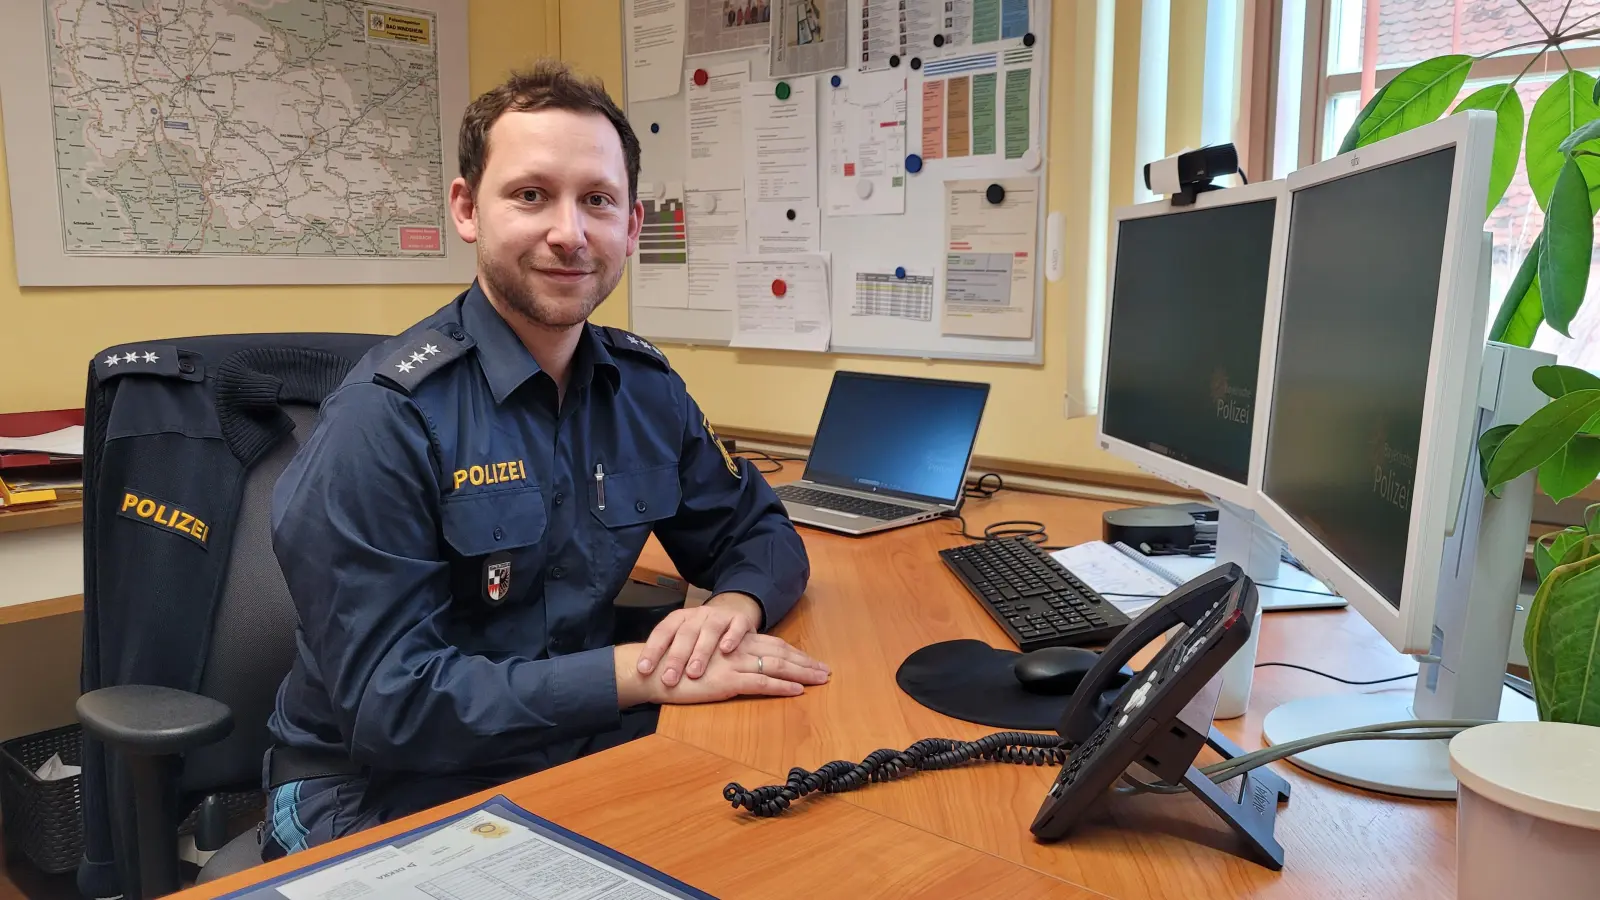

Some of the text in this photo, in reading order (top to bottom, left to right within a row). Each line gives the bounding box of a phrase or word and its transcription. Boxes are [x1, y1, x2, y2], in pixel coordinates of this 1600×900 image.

[1217, 399, 1250, 425] Polizei
[453, 459, 527, 490] POLIZEI
[1373, 465, 1411, 511] Polizei
[121, 493, 209, 543] POLIZEI
[1252, 782, 1272, 815] AVAYA
